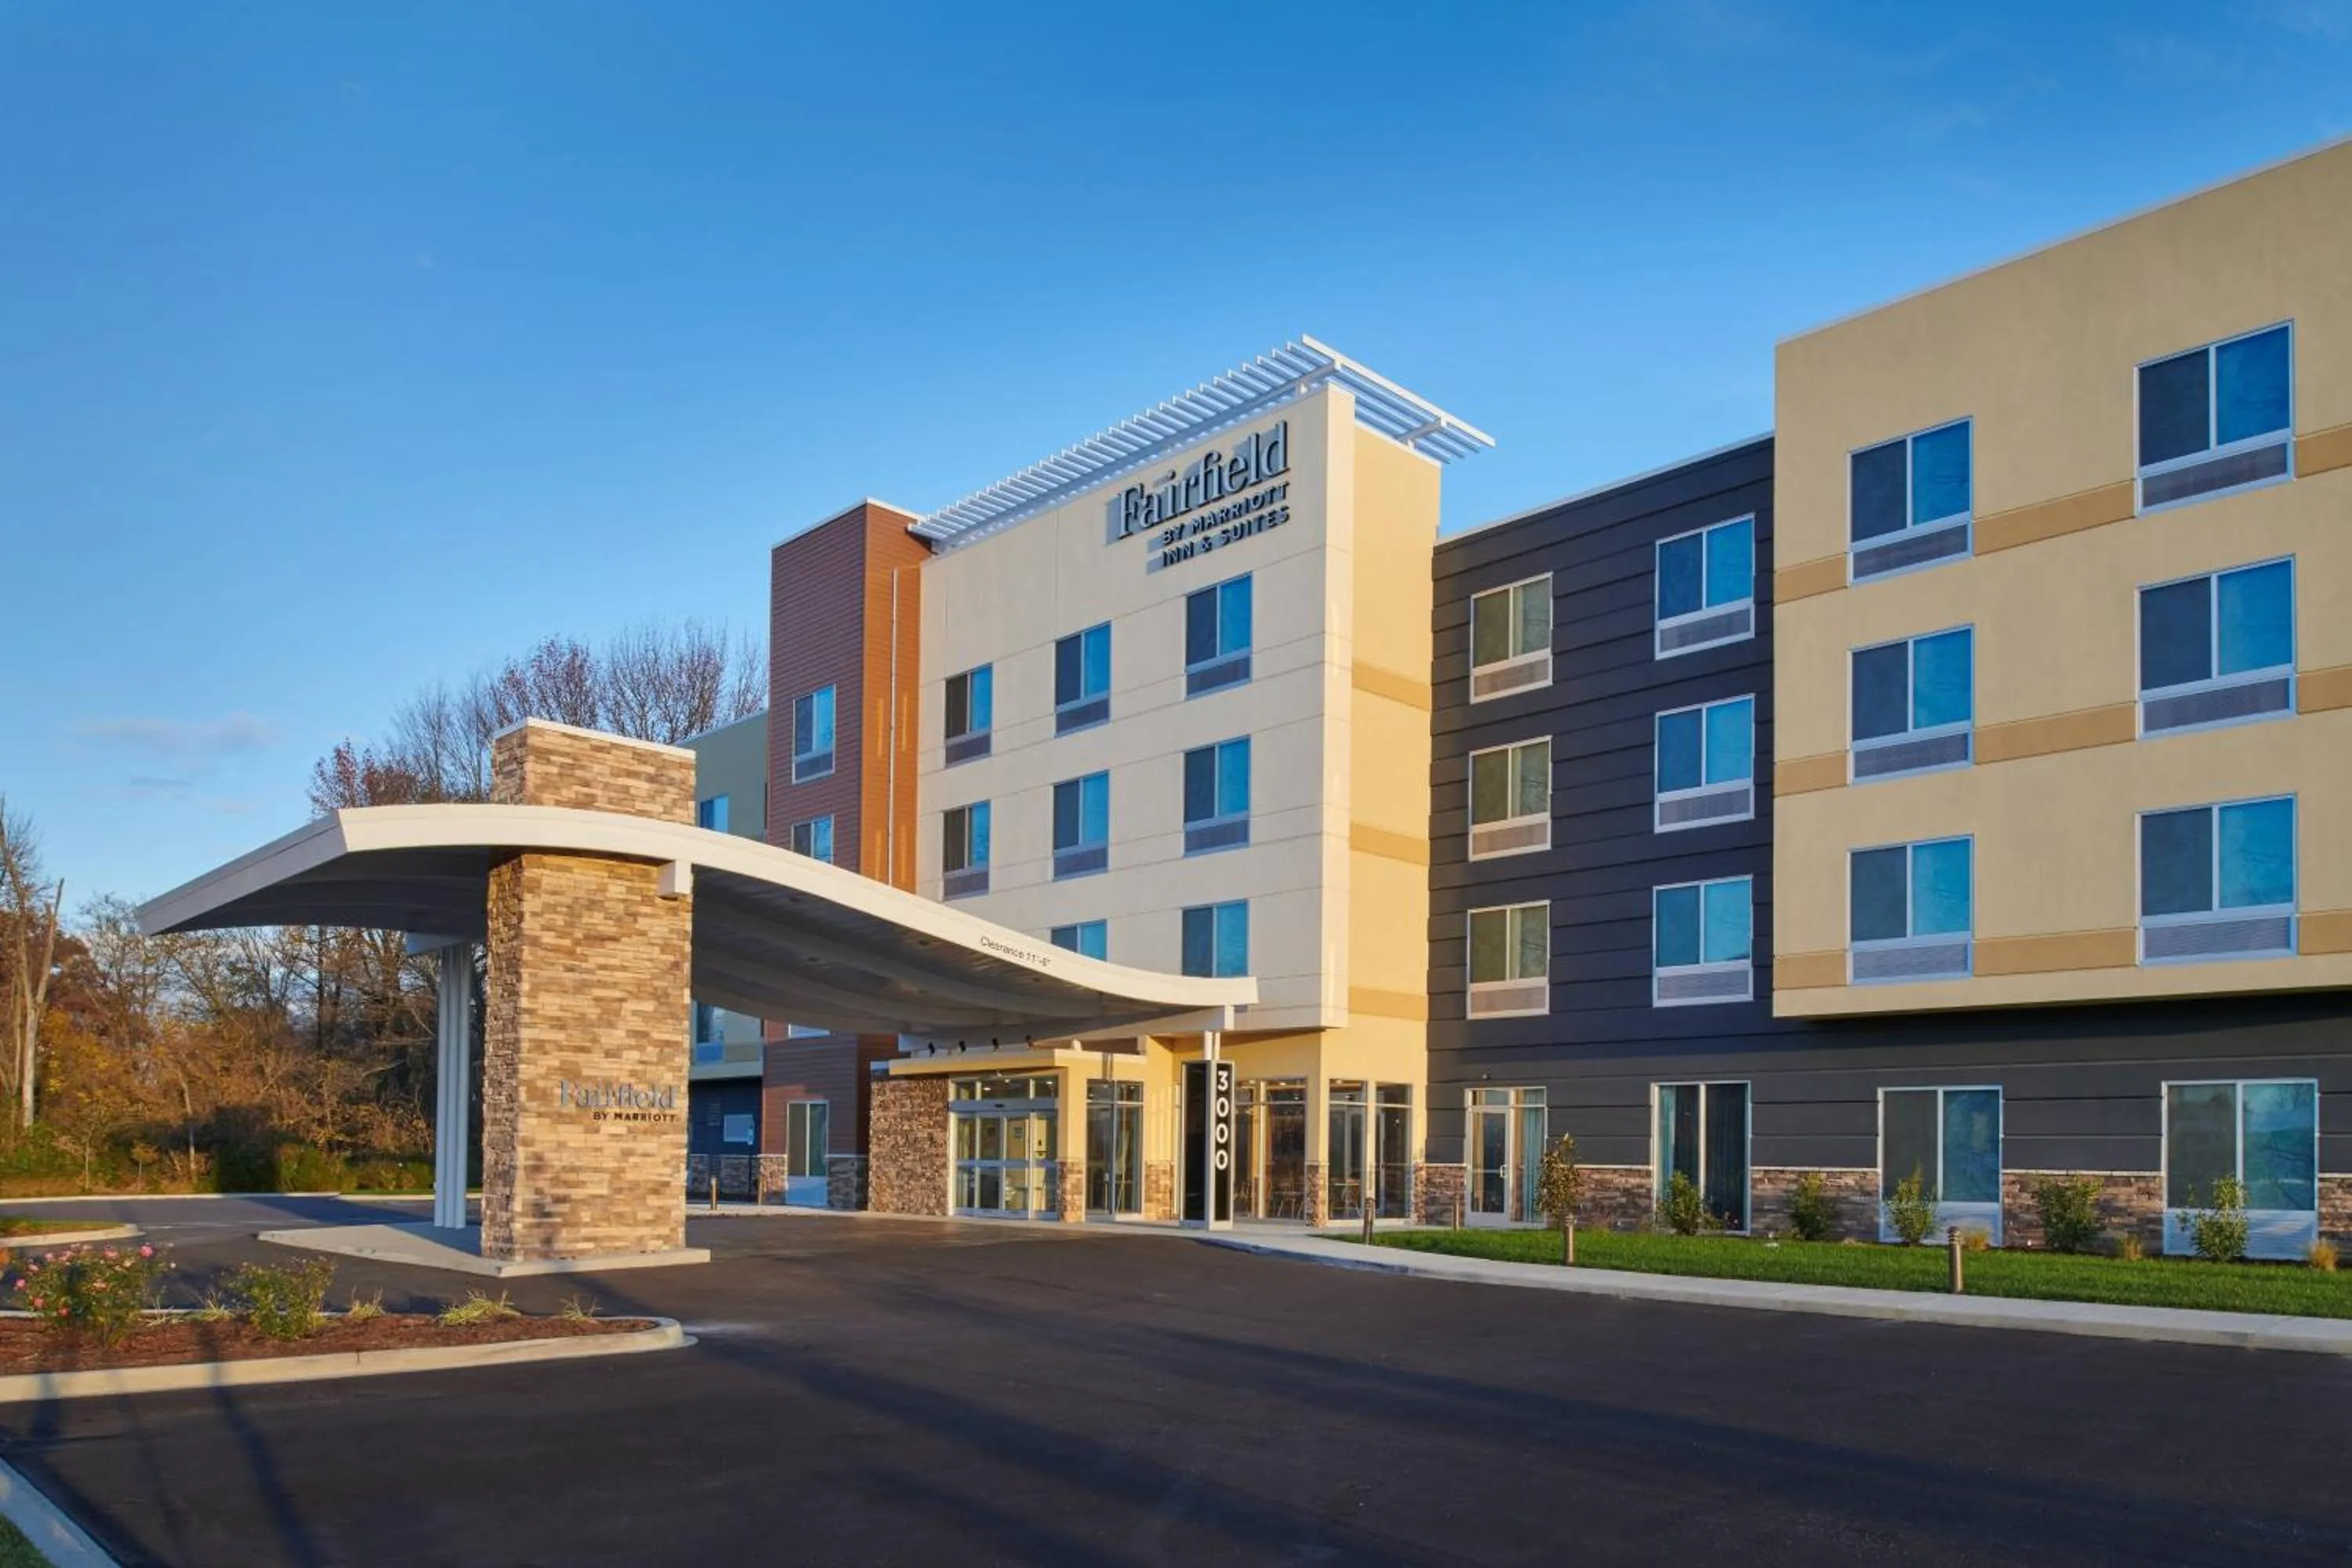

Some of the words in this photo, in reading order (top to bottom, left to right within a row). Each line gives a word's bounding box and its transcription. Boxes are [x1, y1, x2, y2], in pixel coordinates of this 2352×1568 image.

[1116, 419, 1290, 540] Fairfield
[1162, 523, 1185, 546] BY
[1192, 480, 1290, 535] MARRIOTT
[1162, 540, 1195, 567] INN
[1201, 535, 1214, 553] &
[1221, 505, 1290, 547] SUITES
[980, 935, 1025, 959] Clearance
[561, 1078, 678, 1109] Fairfield
[593, 1111, 608, 1122] BY
[614, 1111, 676, 1123] MARRIOTT
[1214, 1070, 1230, 1171] 3000
